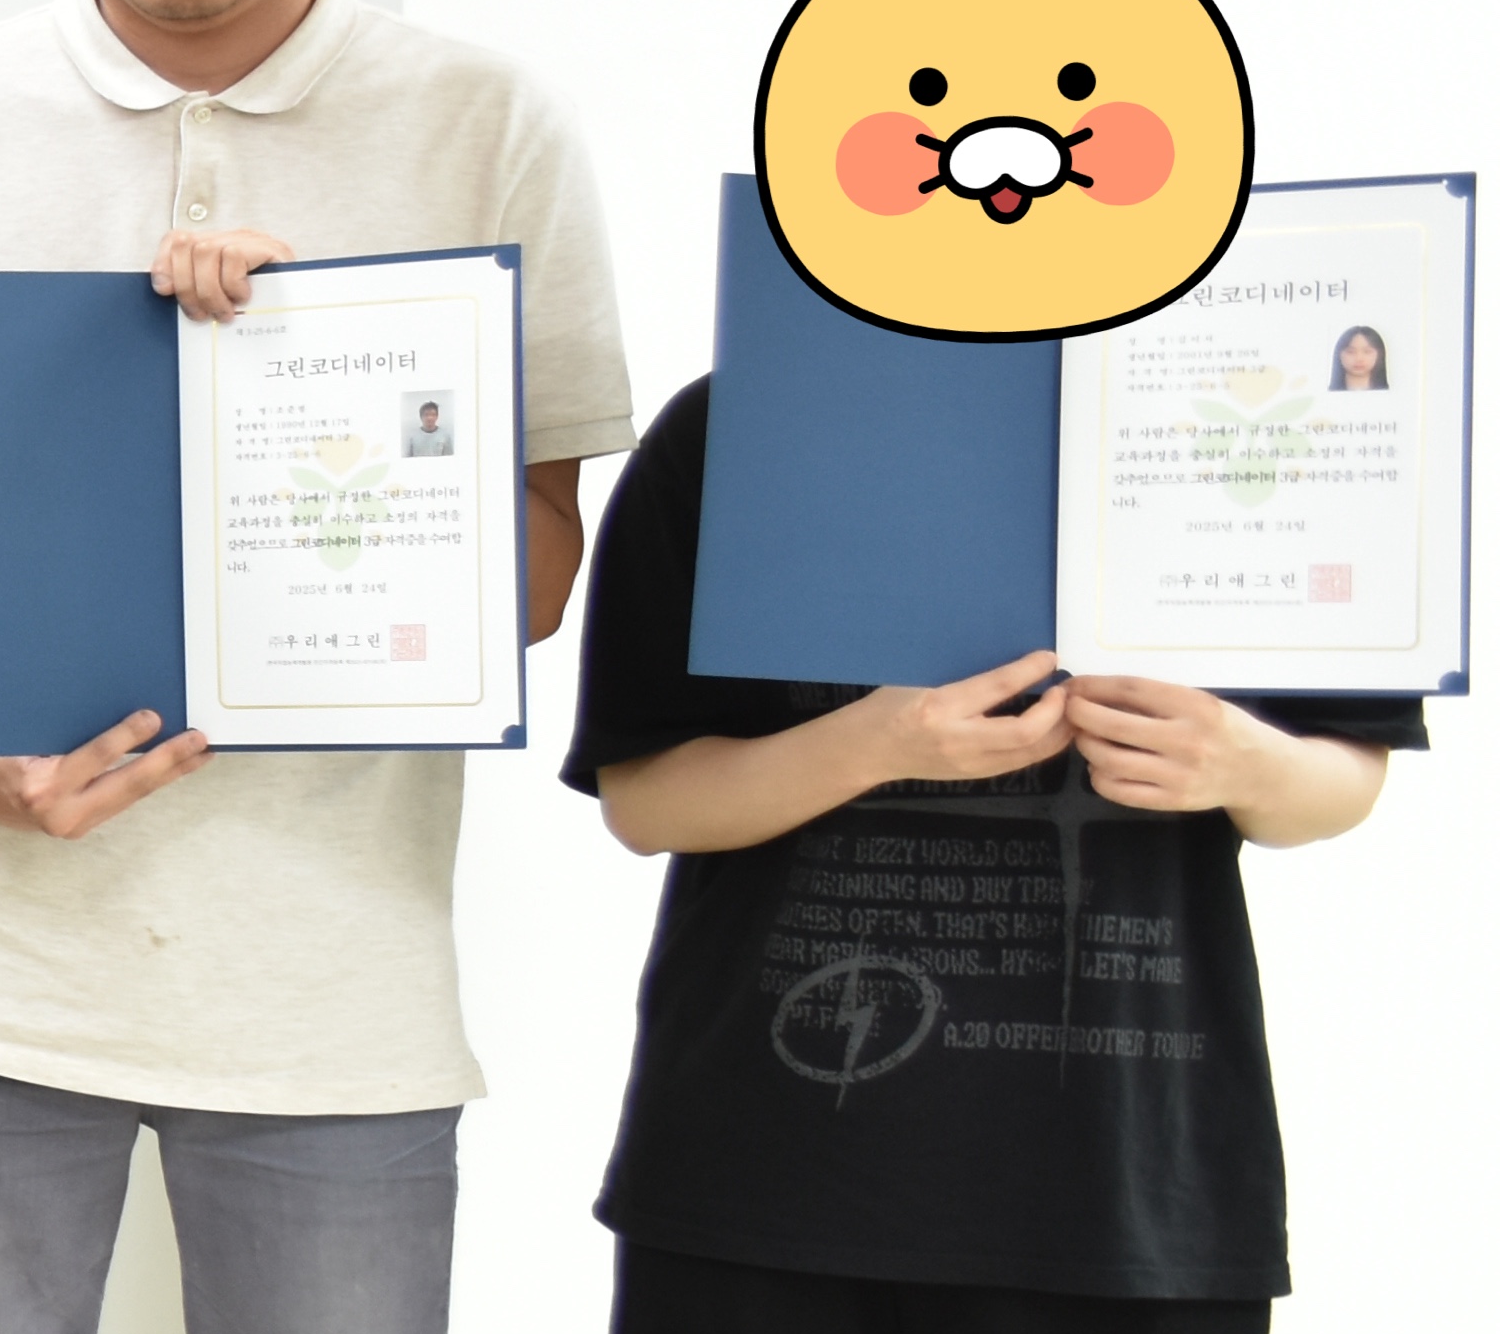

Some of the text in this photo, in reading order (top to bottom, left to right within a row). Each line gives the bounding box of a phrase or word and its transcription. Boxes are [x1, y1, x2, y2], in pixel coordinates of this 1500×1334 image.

[266, 350, 415, 378] 그린코디네이터
[288, 581, 387, 595] 2025년 6월 24일
[920, 874, 966, 903] AND
[971, 875, 1013, 905] BUY
[932, 910, 1008, 940] THAT'S
[1118, 915, 1174, 947] MEN'S
[1078, 950, 1137, 981] LET'S
